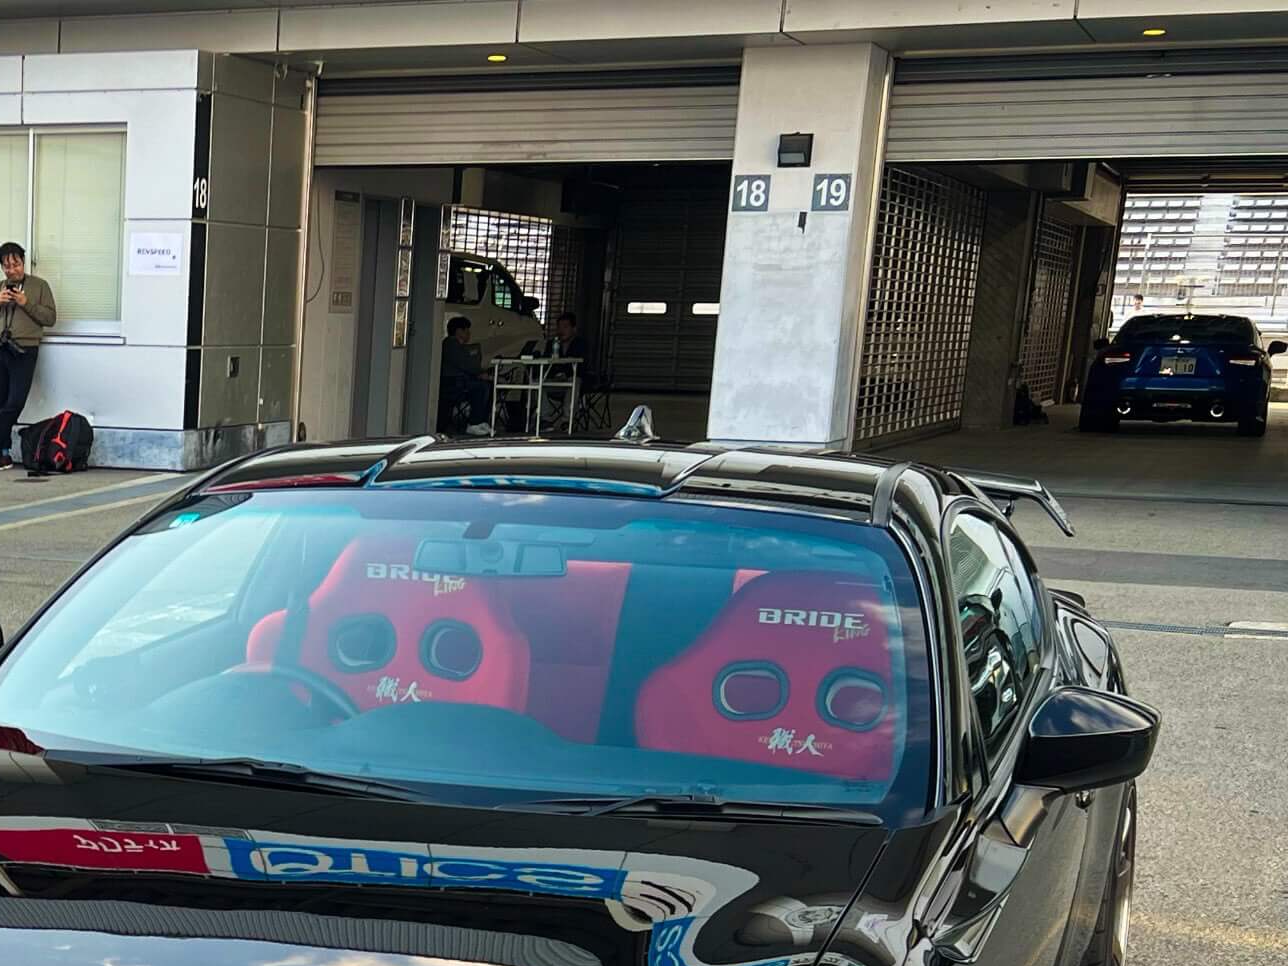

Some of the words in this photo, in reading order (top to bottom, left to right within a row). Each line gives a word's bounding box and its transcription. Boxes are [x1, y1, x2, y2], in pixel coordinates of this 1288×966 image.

[193, 177, 208, 209] 18
[736, 179, 766, 208] 18
[816, 178, 847, 207] 19
[758, 607, 864, 629] BRIDE
